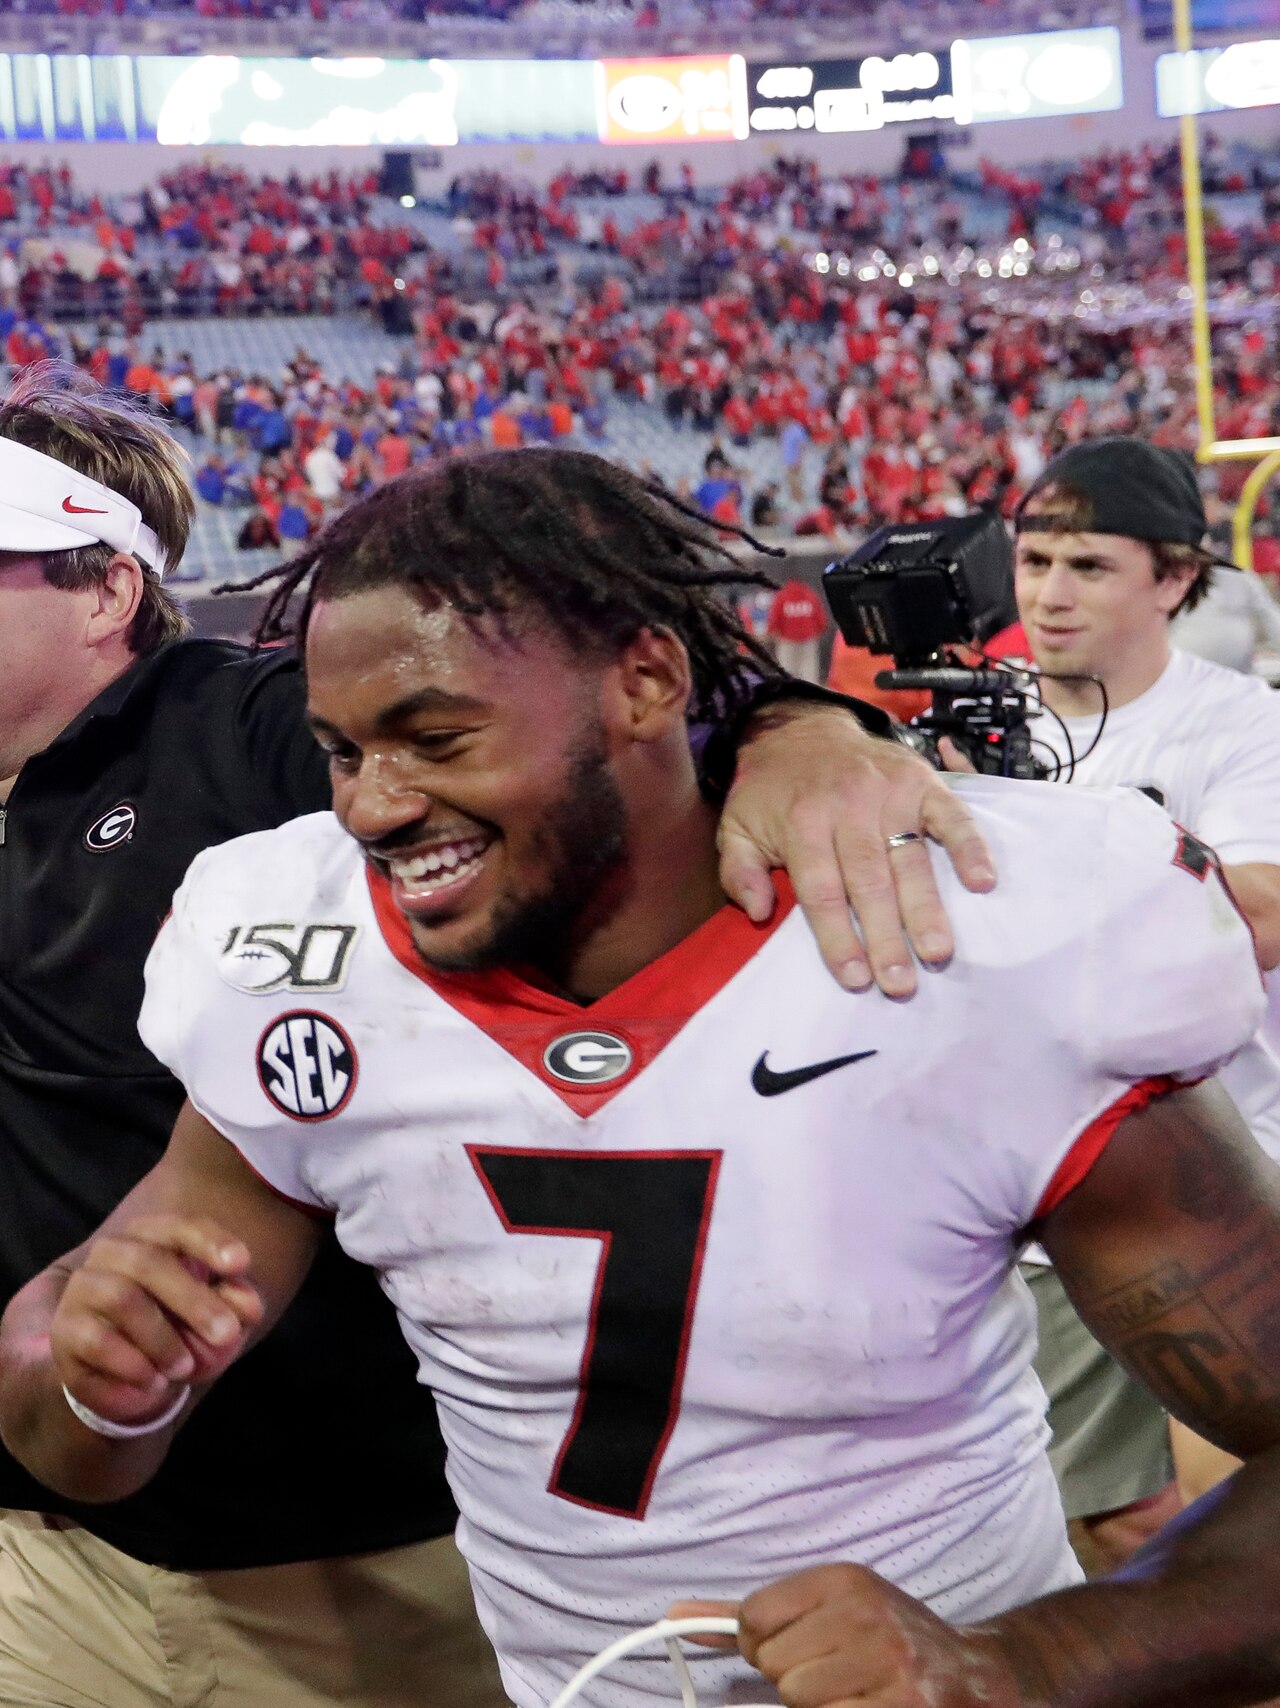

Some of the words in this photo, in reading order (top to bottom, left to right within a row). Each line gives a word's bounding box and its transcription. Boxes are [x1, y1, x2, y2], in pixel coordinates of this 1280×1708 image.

[87, 806, 134, 848] G
[222, 924, 357, 989] 150
[262, 1017, 350, 1116] SEC
[545, 1031, 631, 1083] G
[464, 1143, 723, 1521] 7
